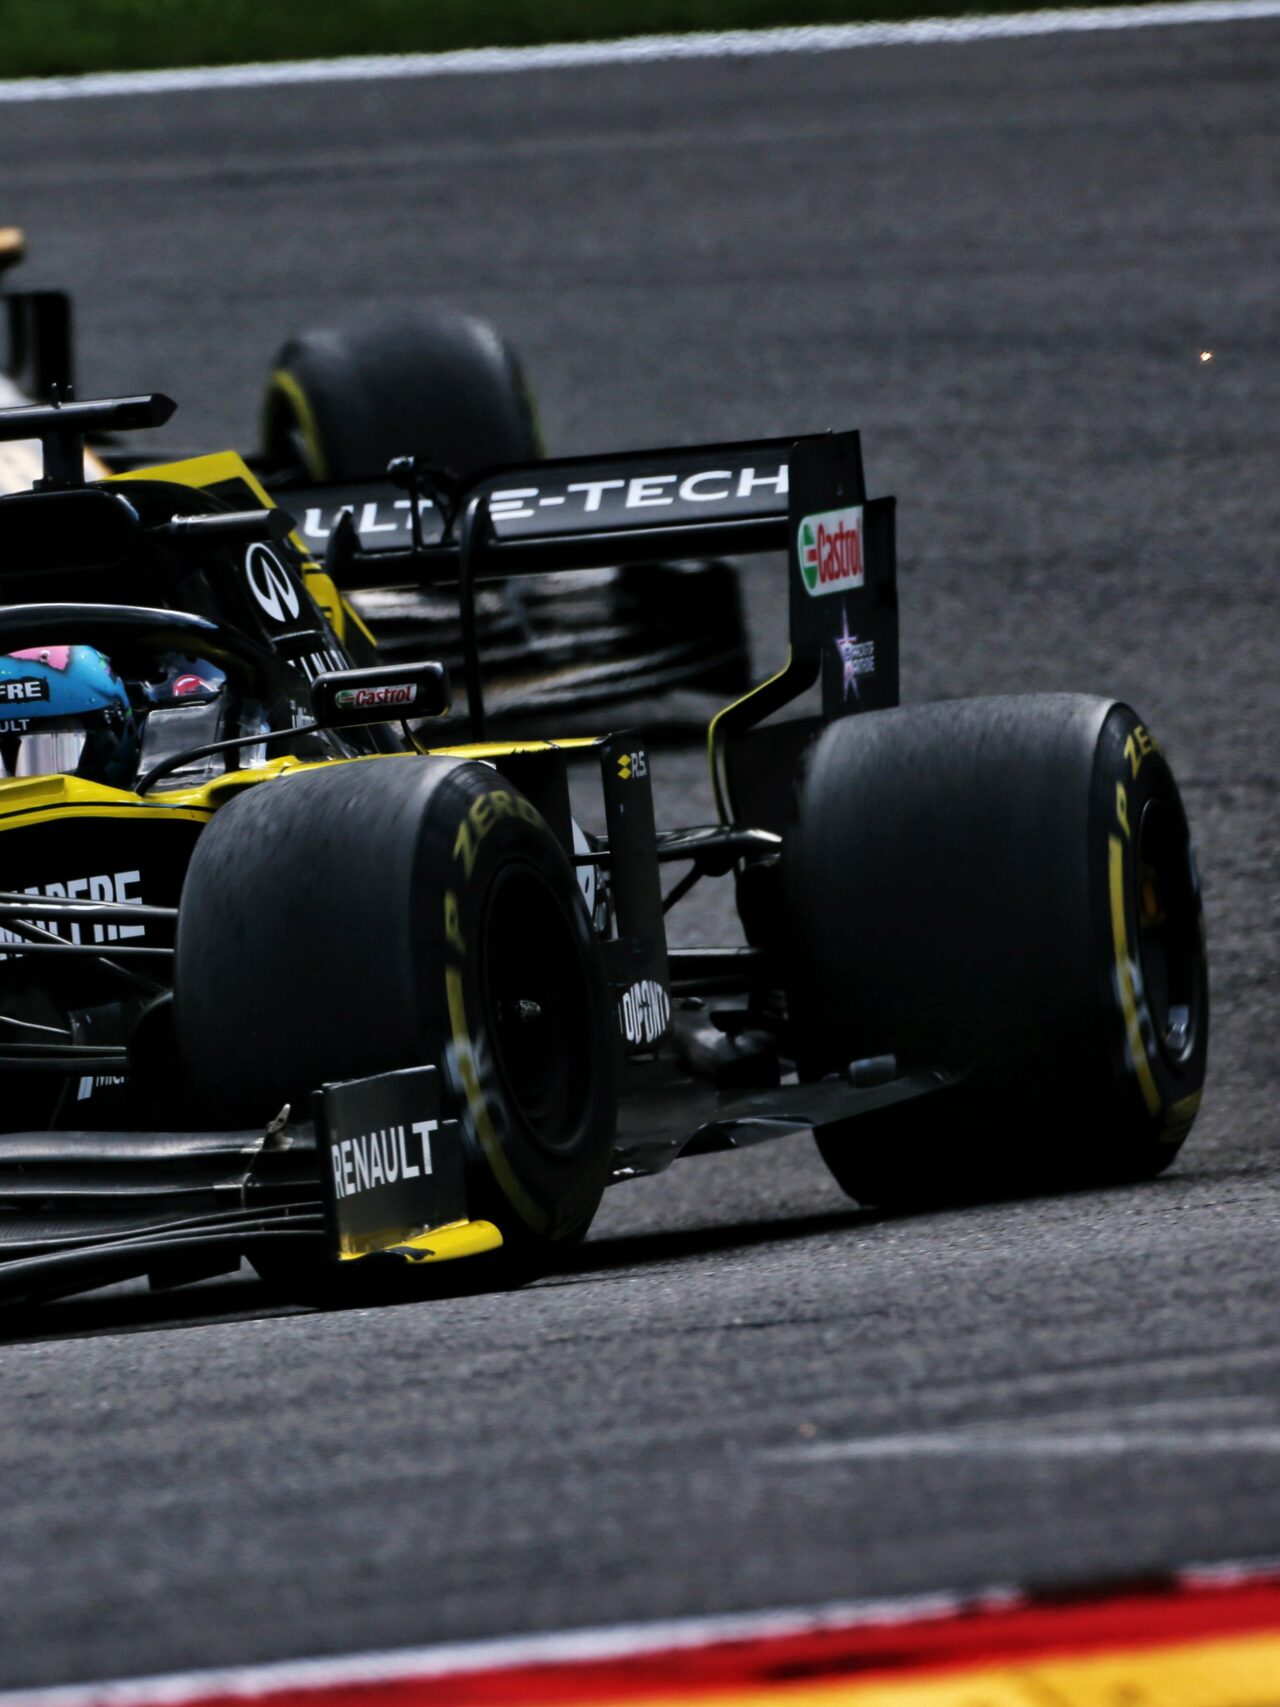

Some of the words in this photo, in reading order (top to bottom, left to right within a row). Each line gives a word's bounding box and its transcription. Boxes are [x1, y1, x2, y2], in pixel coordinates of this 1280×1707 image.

[488, 464, 790, 521] E-TECH
[816, 517, 863, 584] Castrol
[355, 685, 412, 706] Castrol
[452, 790, 546, 882] ZERO
[330, 1118, 439, 1199] RENAULT
